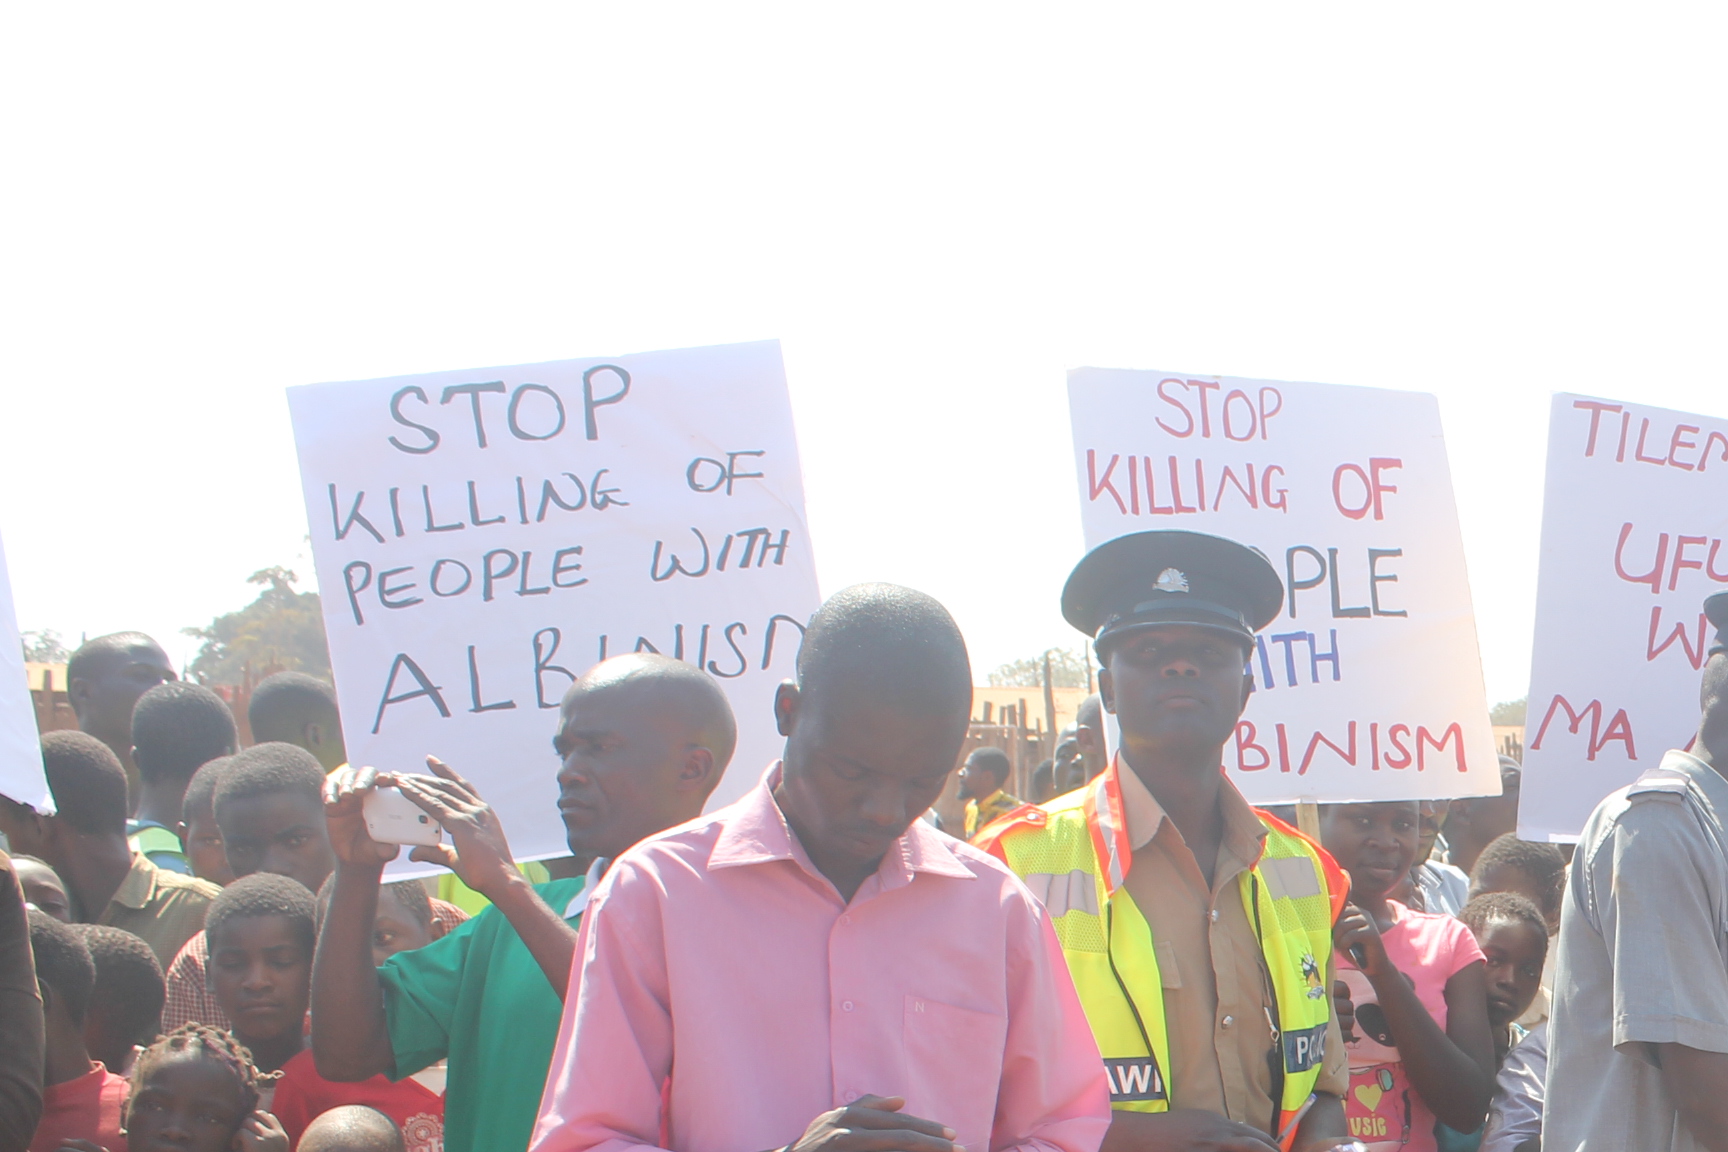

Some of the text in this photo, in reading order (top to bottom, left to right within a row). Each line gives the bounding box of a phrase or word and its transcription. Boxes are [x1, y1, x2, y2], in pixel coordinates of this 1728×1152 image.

[388, 364, 631, 454] STOP
[1154, 378, 1283, 442] STOP
[328, 450, 766, 543] KILLING OF
[1087, 449, 1403, 521] KILLING OF
[343, 527, 790, 626] PEOPLE WITH
[1249, 545, 1408, 618] PLE
[1243, 628, 1341, 693] ITH
[1647, 605, 1709, 671] W
[1235, 719, 1468, 775] BINISM
